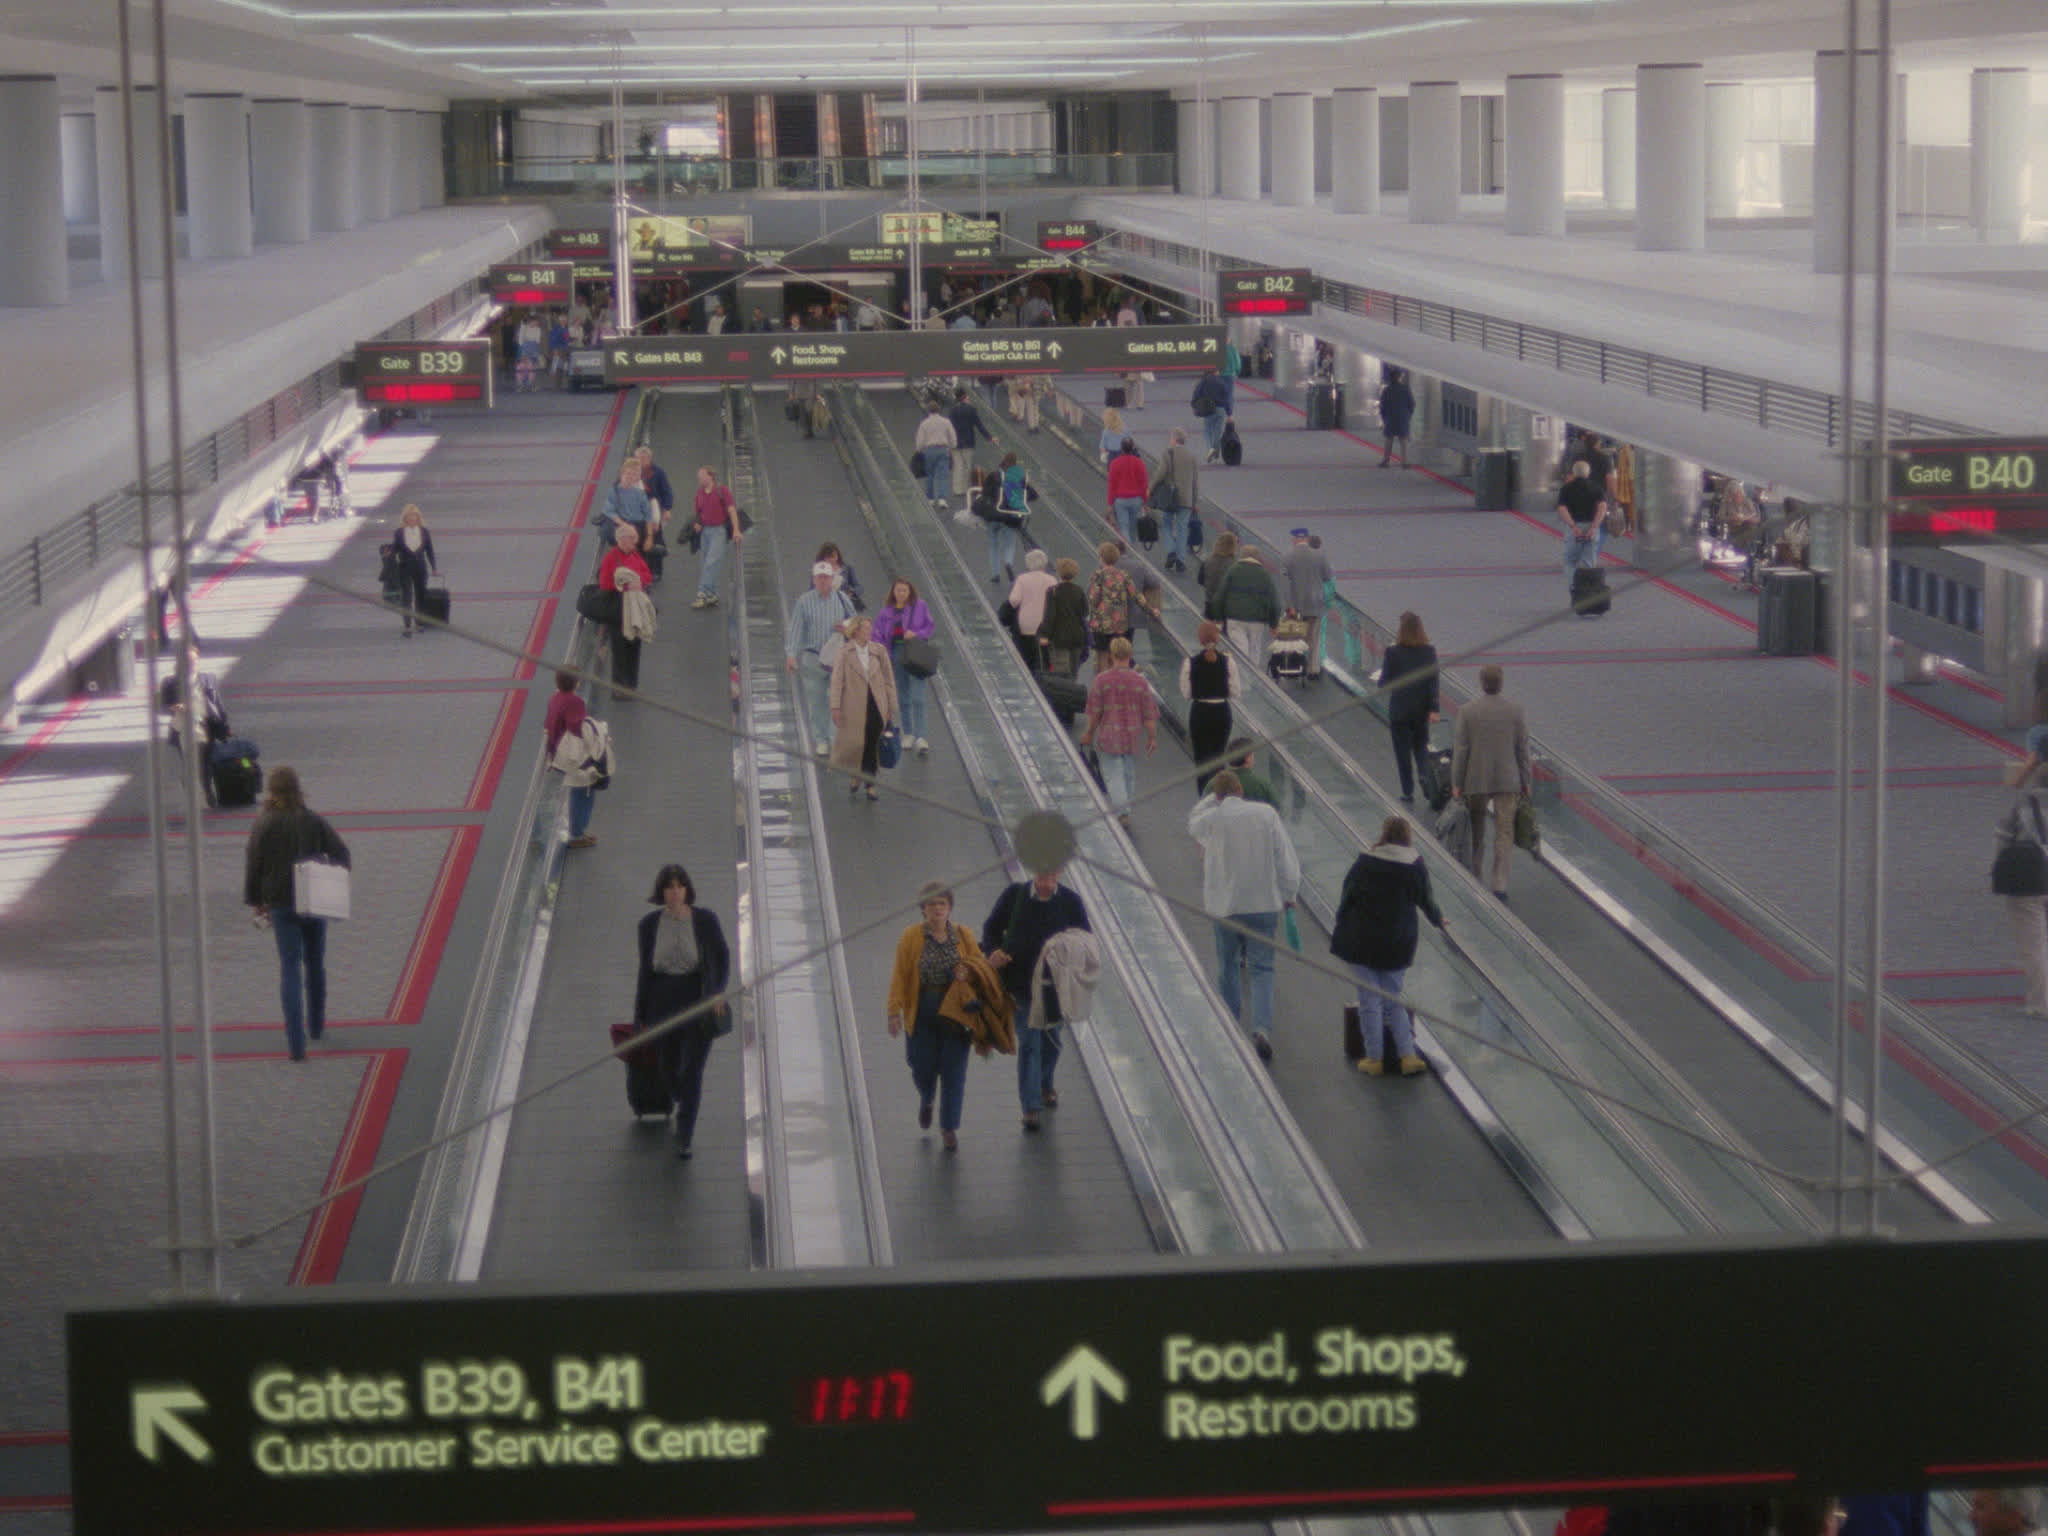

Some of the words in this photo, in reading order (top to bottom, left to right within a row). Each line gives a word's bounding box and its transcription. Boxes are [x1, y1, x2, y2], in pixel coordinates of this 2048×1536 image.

[1065, 225, 1085, 236] B44
[507, 273, 526, 282] Gate
[531, 271, 555, 285] B41
[1237, 281, 1257, 290] Gate
[1264, 276, 1294, 292] B42
[963, 341, 989, 351] Gates
[1012, 341, 1023, 351] to
[1128, 343, 1154, 353] Gates
[381, 357, 410, 370] Gate
[420, 351, 463, 373] B39
[635, 352, 661, 363] Gates
[792, 355, 838, 365] Restrooms
[1908, 465, 1952, 483] Gate
[1968, 454, 2034, 489] B40
[1165, 1332, 1300, 1384] Food,
[1316, 1328, 1467, 1384] Shops,
[252, 1370, 405, 1422] Gates
[422, 1363, 538, 1420] B39,
[554, 1357, 643, 1412] B41
[1166, 1390, 1417, 1440] Restrooms
[254, 1433, 456, 1476] Customer
[471, 1423, 617, 1468] Service
[630, 1420, 768, 1463] Center
